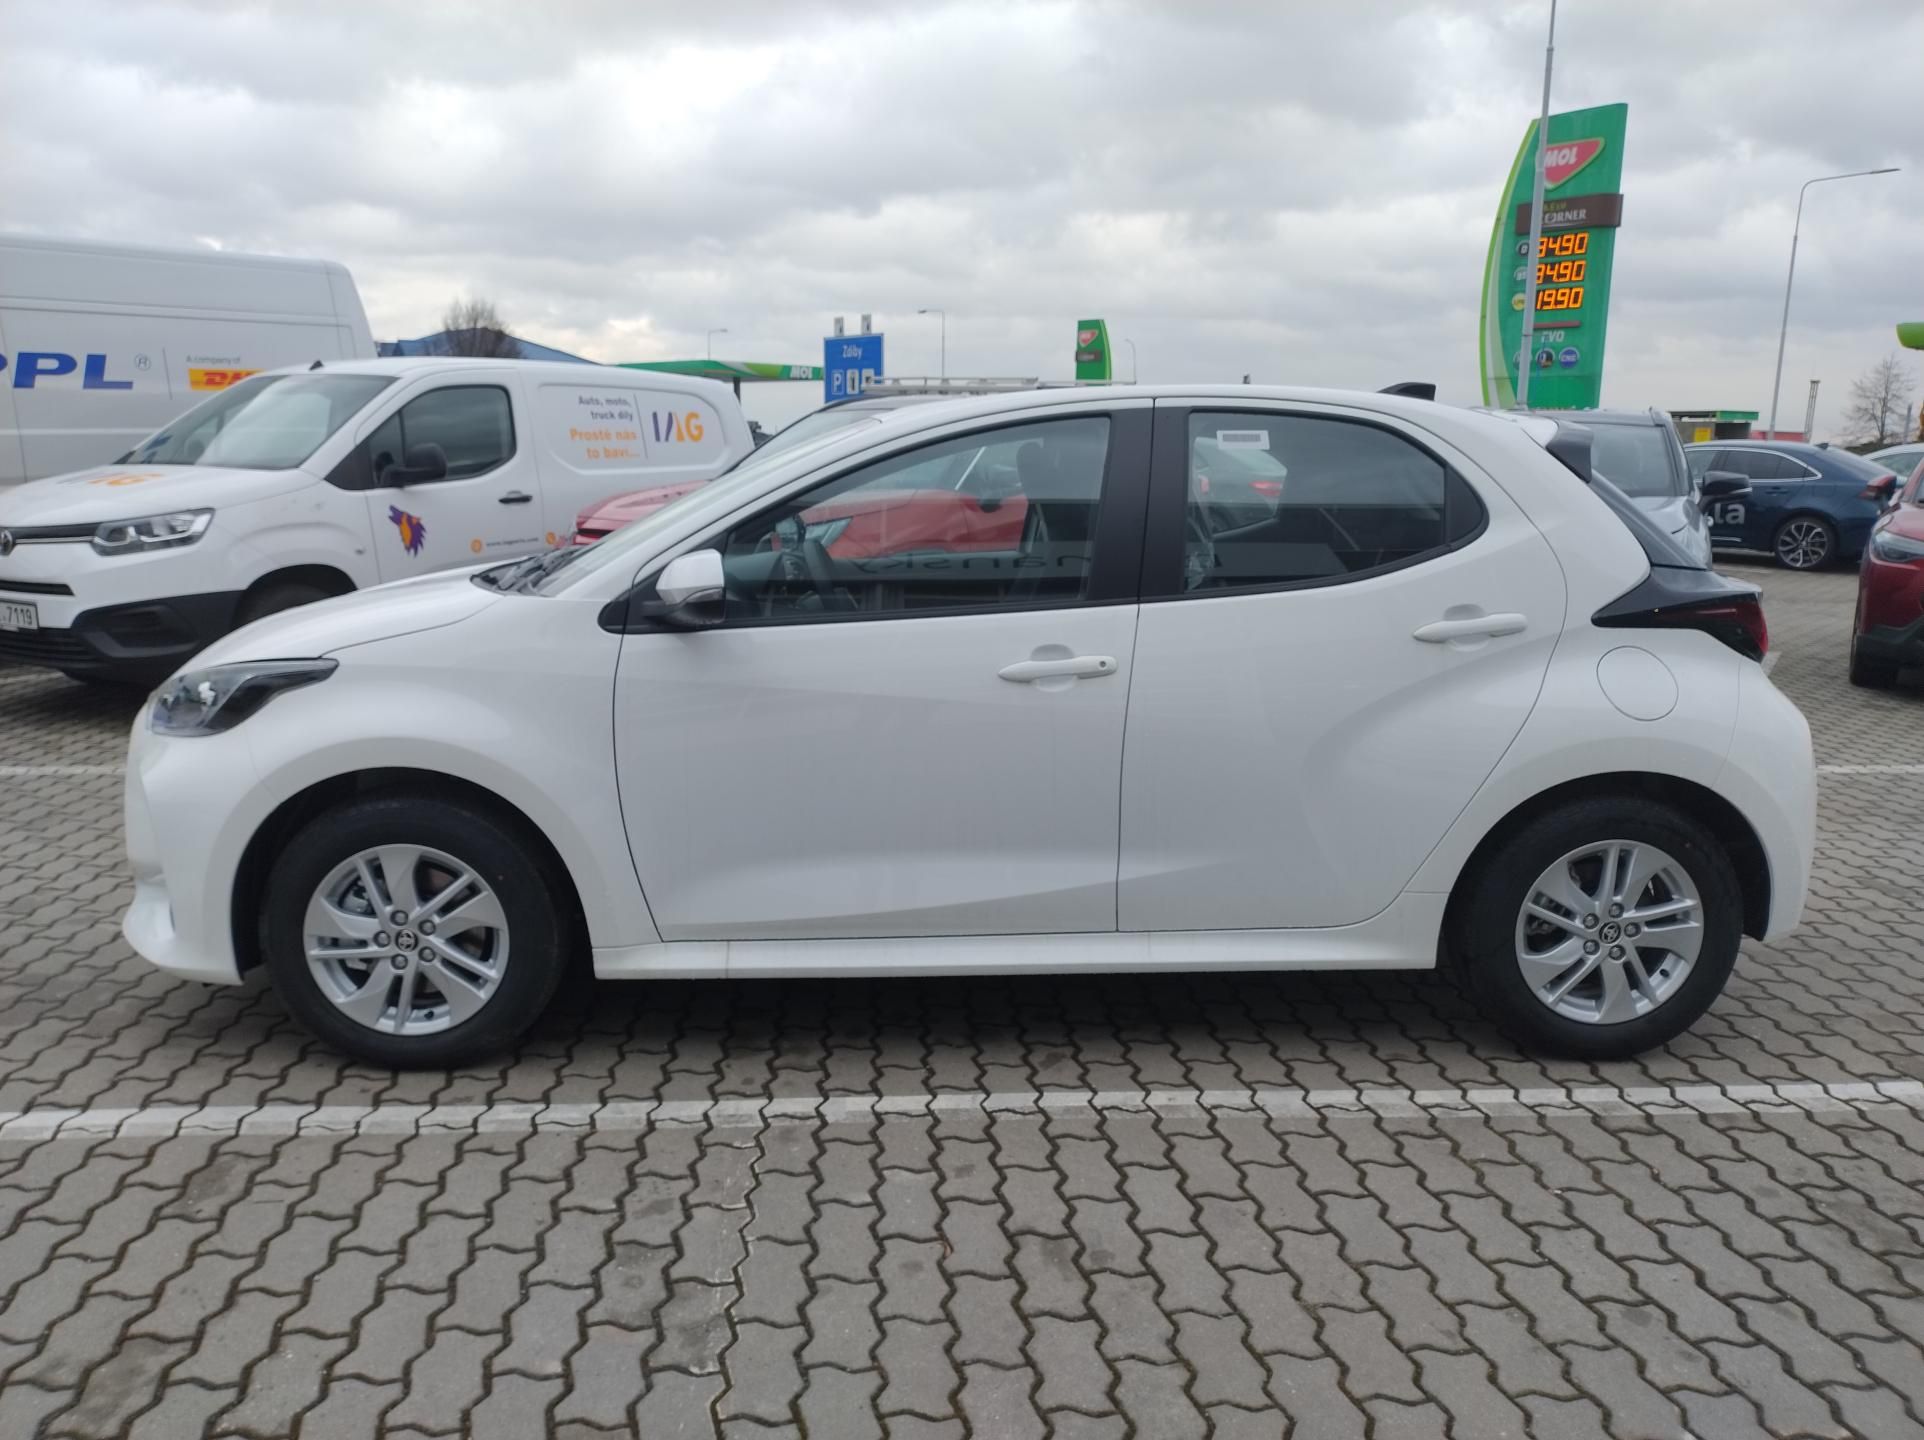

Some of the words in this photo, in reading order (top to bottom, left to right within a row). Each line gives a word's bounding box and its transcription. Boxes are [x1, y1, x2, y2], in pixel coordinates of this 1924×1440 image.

[1545, 146, 1578, 168] MOL
[0, 351, 134, 390] PL
[590, 410, 616, 420] truck
[586, 447, 600, 459] to
